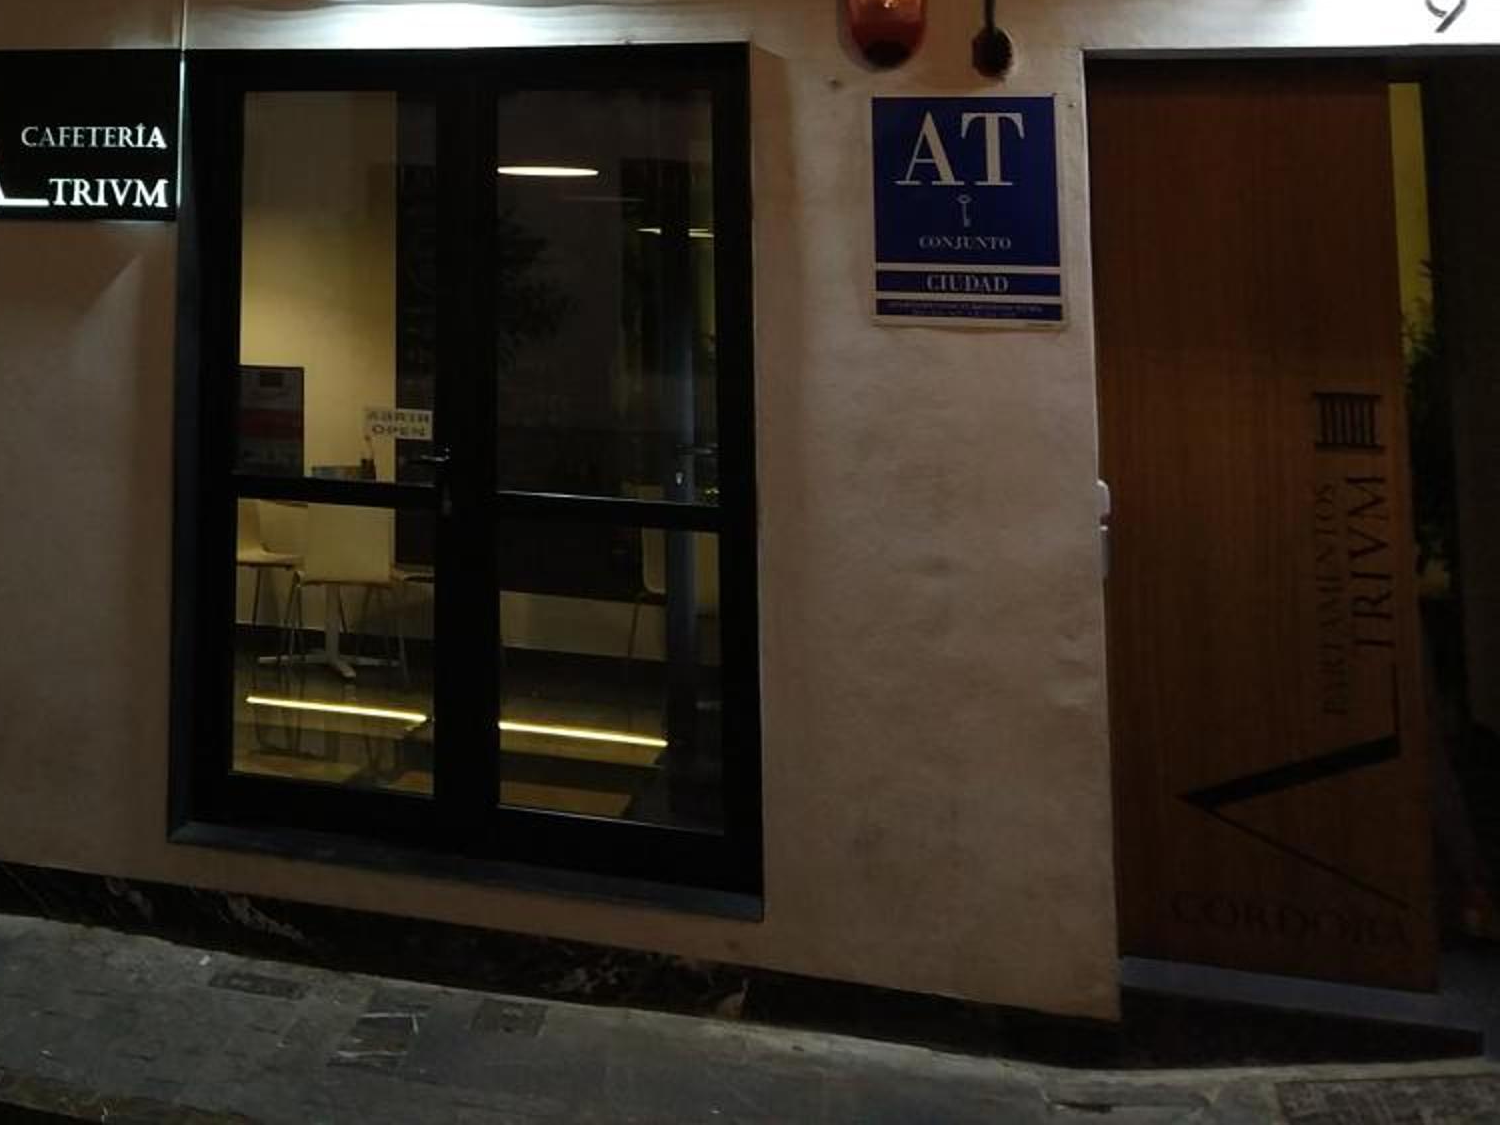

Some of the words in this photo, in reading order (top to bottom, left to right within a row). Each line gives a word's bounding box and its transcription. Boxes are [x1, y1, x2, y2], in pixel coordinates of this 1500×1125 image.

[20, 122, 168, 150] CAFETERÍA
[894, 109, 1027, 188] AT
[49, 177, 170, 208] TRIVM
[917, 234, 1013, 253] CONJUNTO
[925, 274, 1011, 295] CIUDAD
[371, 424, 426, 437] OPEN
